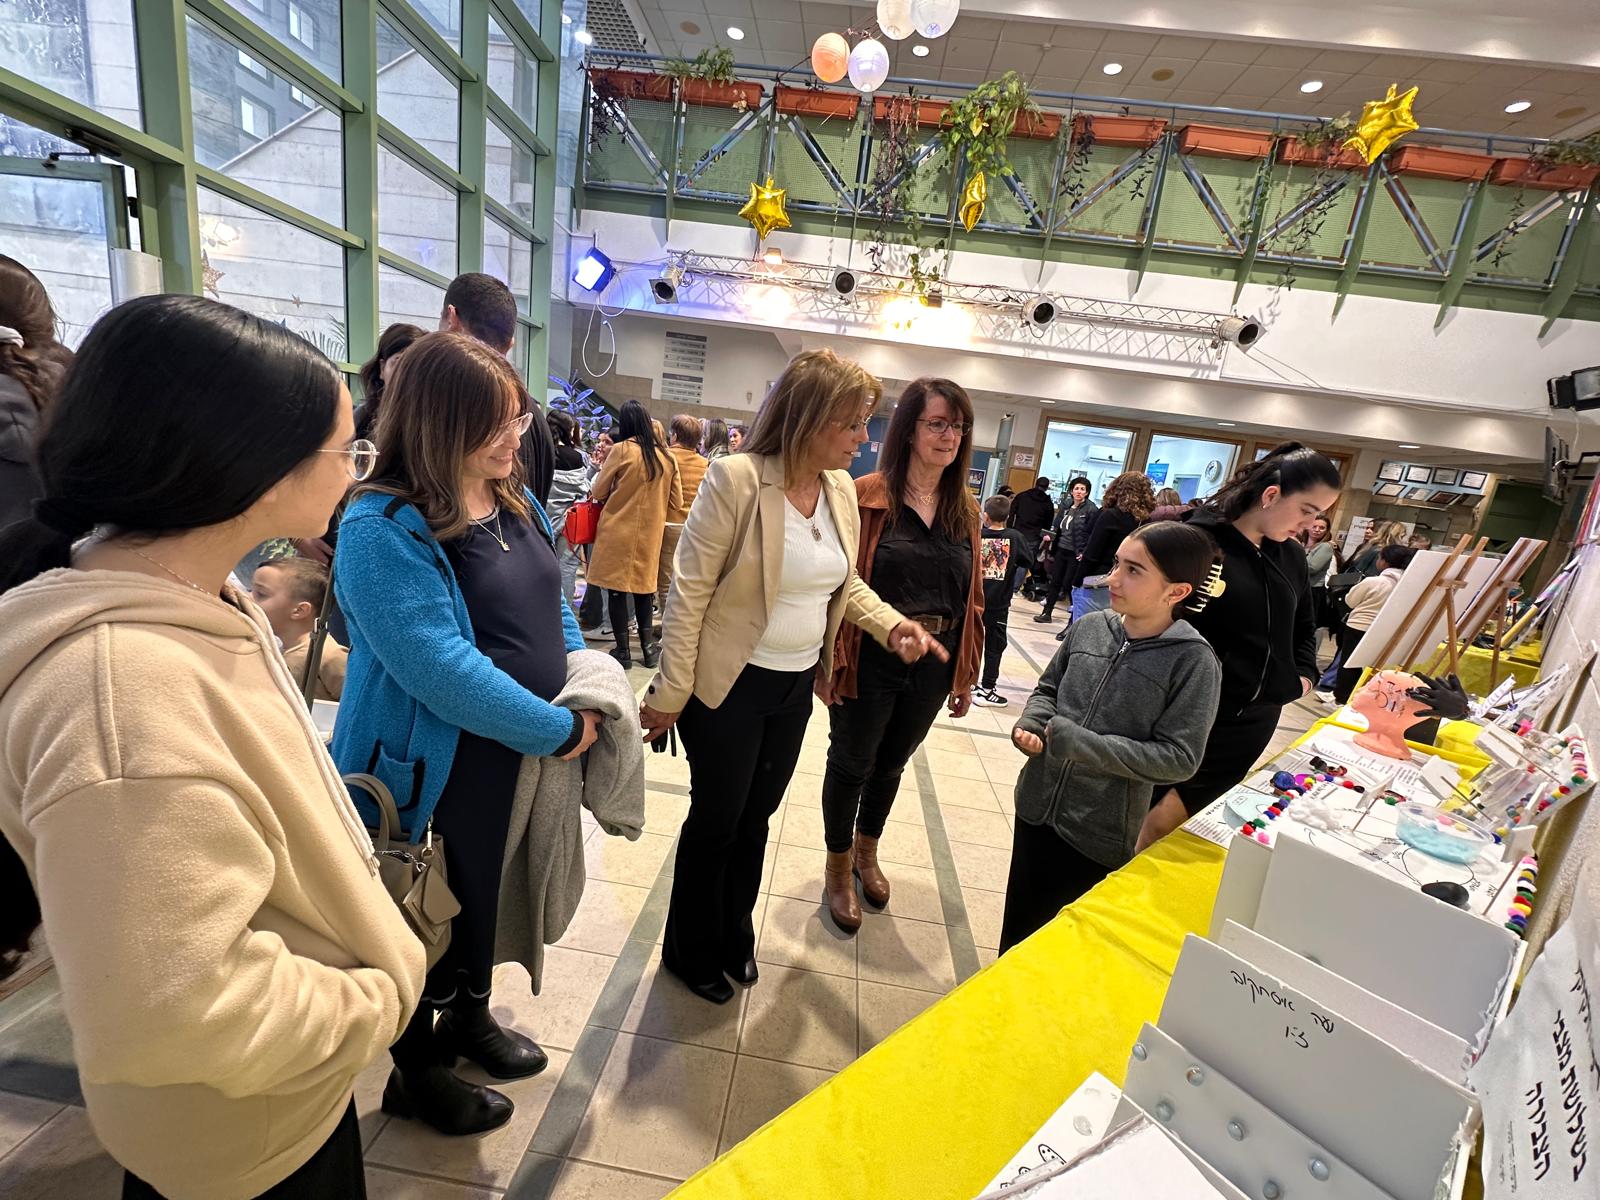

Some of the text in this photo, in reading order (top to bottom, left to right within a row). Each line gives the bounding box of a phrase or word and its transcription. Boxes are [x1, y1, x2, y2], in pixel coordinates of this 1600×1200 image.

[1525, 1081, 1551, 1182] הצבירה
[1552, 1009, 1588, 1183] בשלושת מצבי
